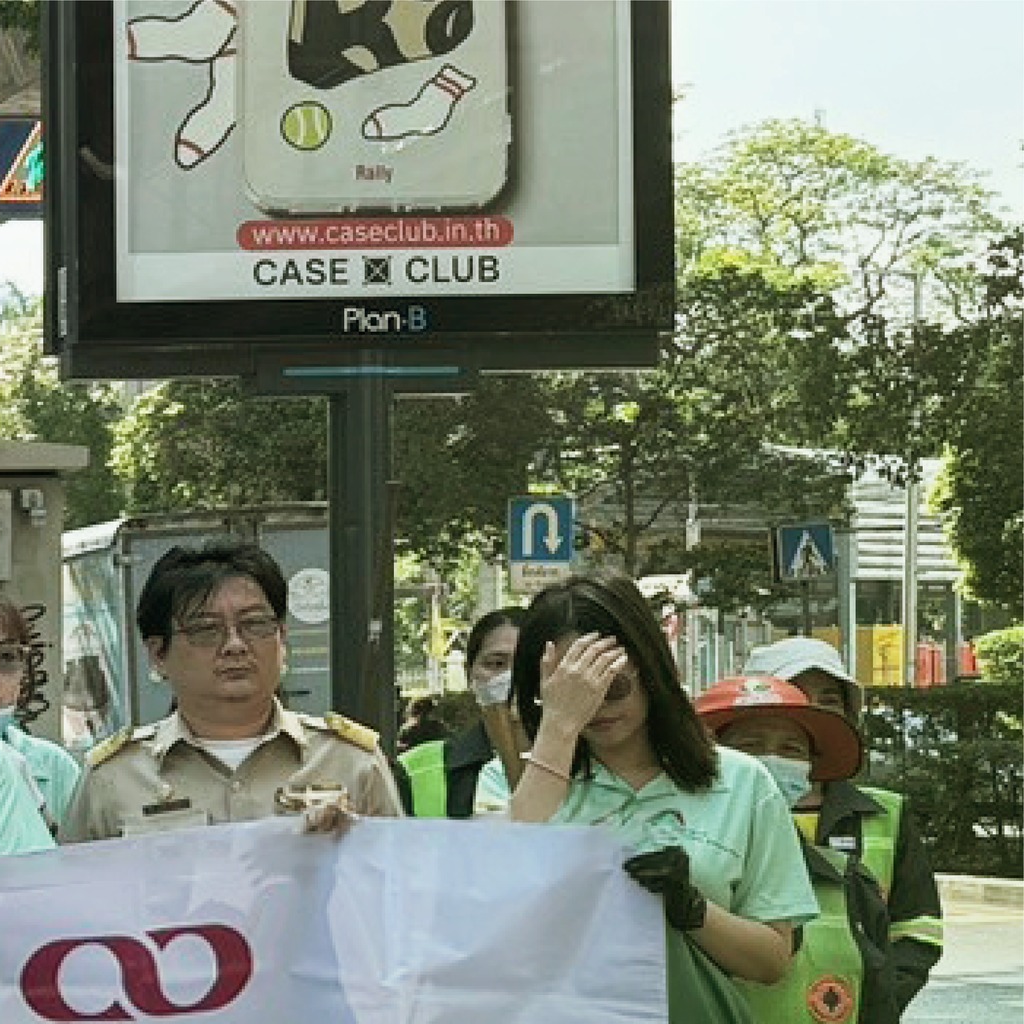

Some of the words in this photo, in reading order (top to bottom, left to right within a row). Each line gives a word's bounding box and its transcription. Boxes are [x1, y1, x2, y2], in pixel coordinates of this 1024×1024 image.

[251, 217, 501, 246] www.caseclub.in.th
[252, 258, 350, 286] CASE
[404, 254, 501, 284] CLUB
